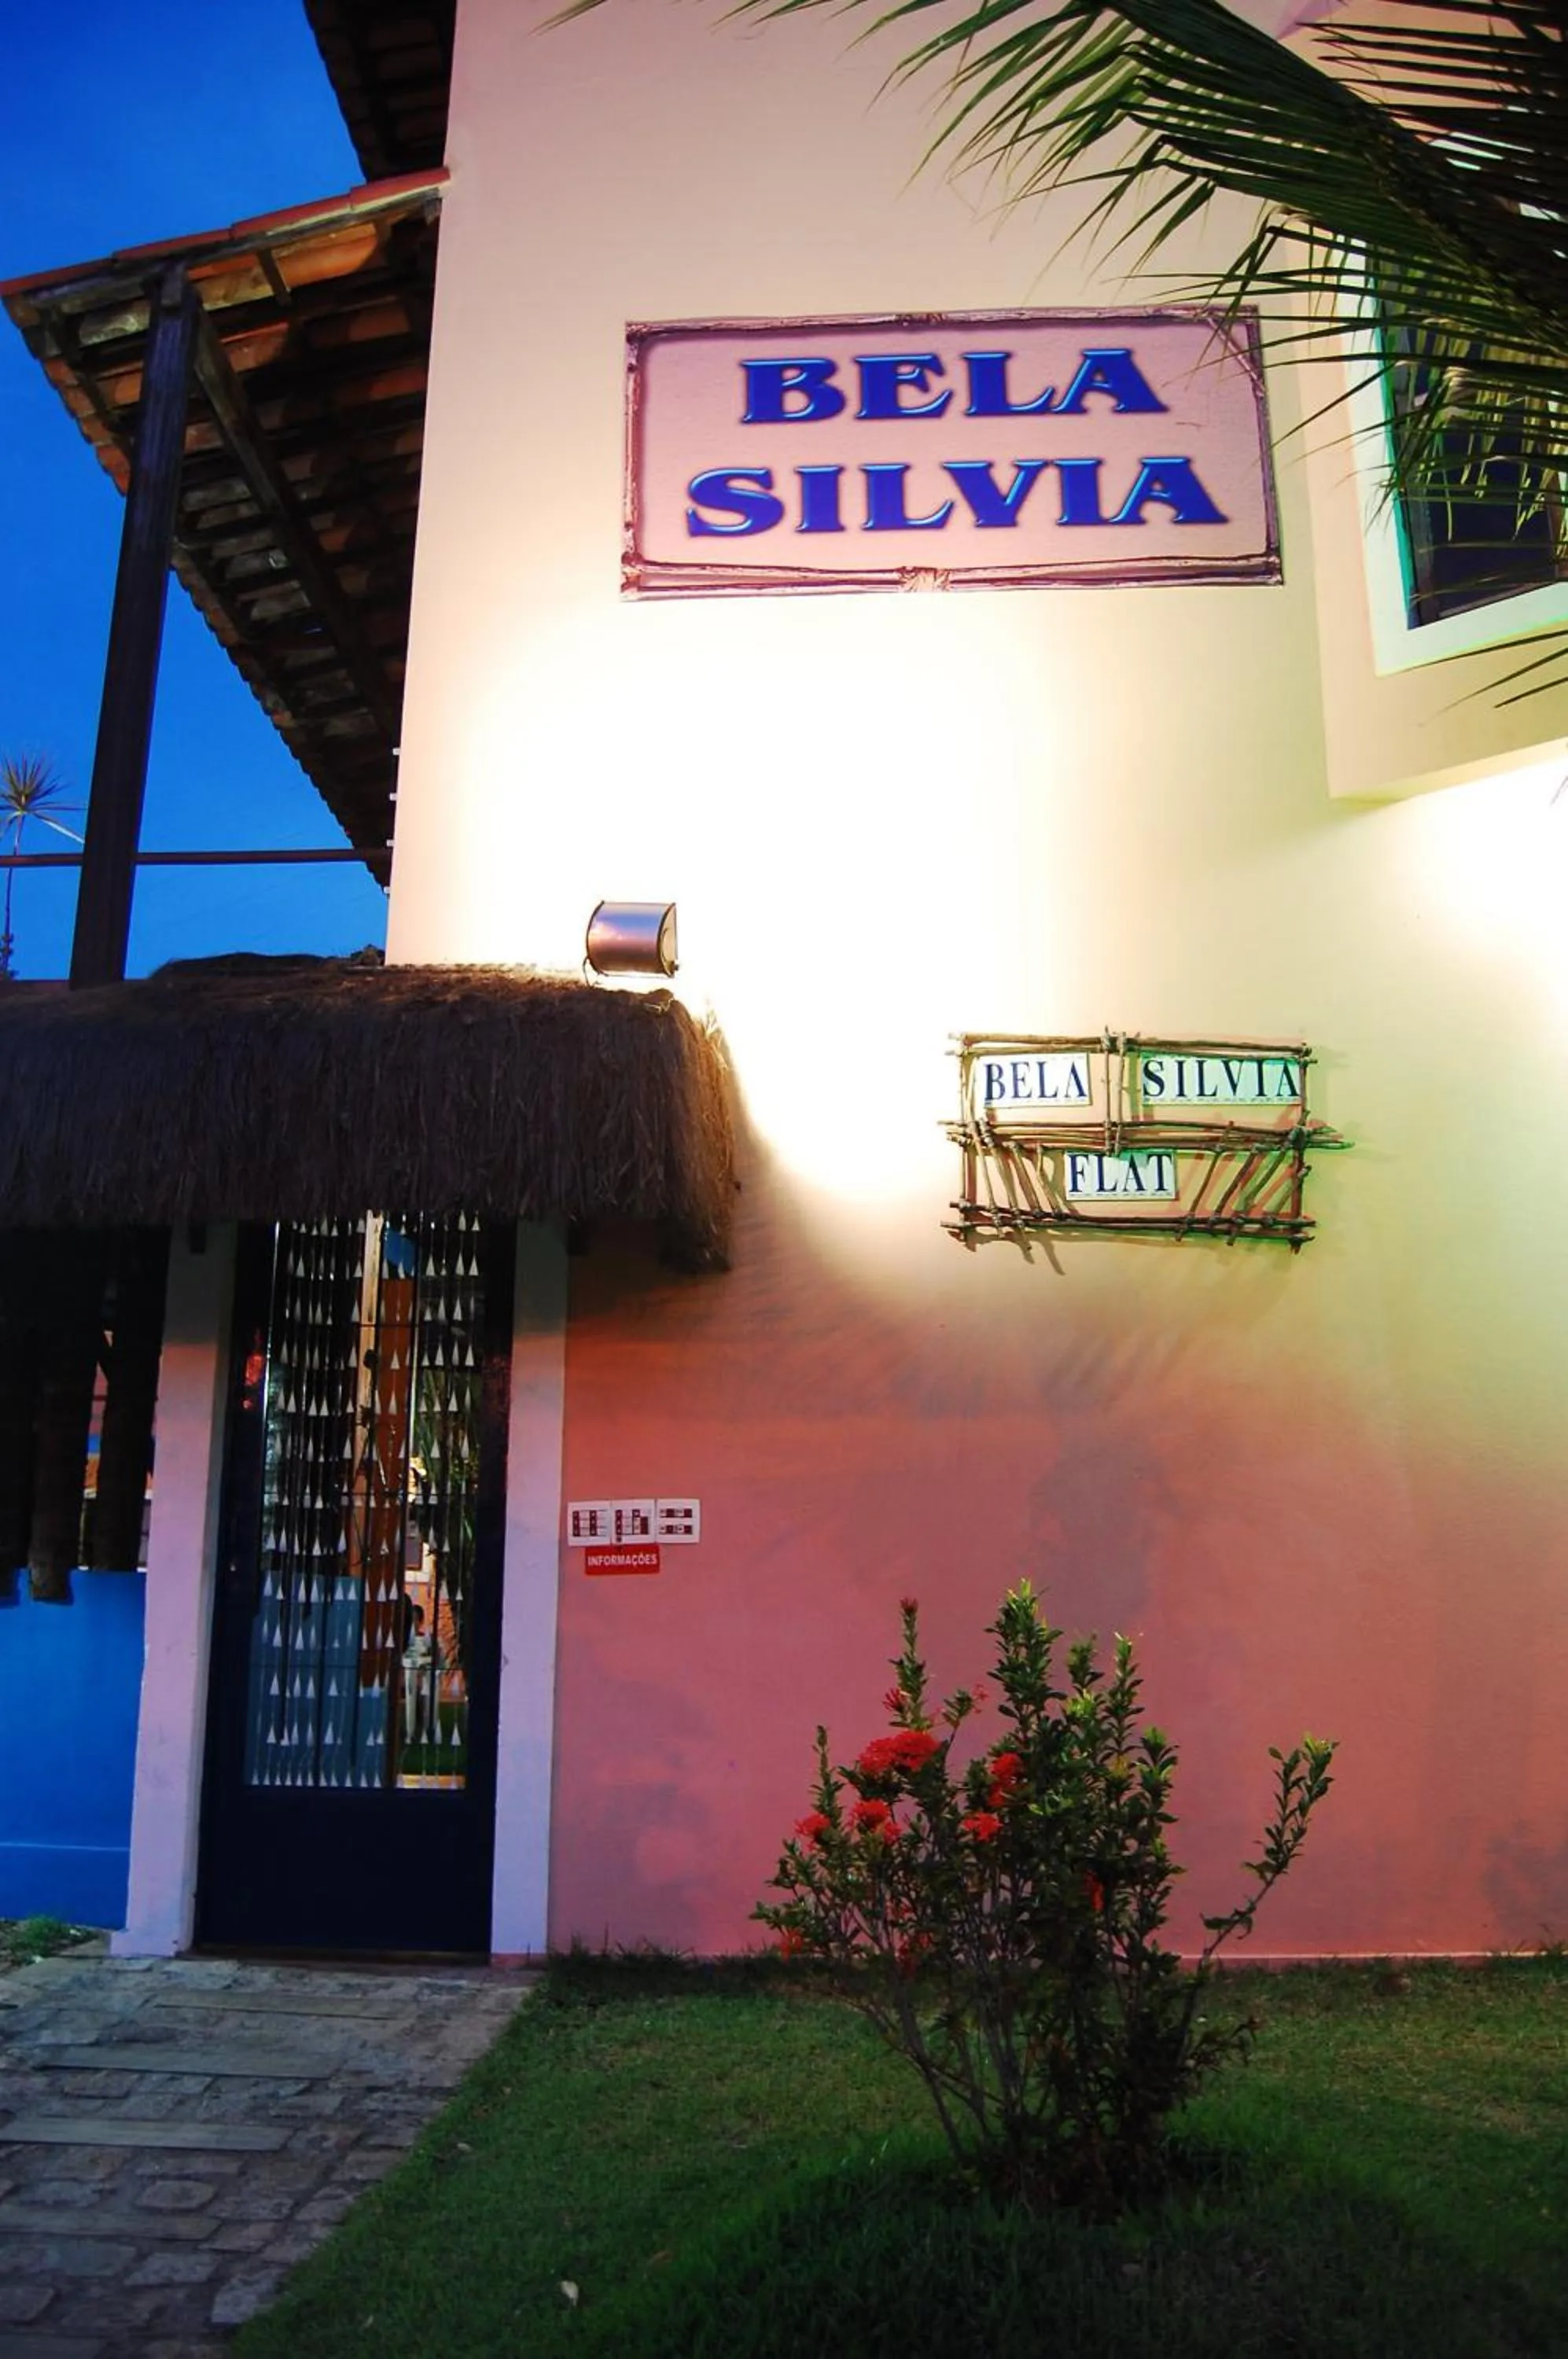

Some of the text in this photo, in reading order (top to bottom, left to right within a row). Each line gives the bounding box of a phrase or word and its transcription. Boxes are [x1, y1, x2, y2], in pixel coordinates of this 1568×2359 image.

[741, 348, 1169, 424] BELA
[686, 456, 1229, 537] SILVIA
[985, 1058, 1301, 1100] BELA SILVIA
[1068, 1153, 1173, 1194] FLAT
[587, 1553, 657, 1567] INFORMAÇÕES
